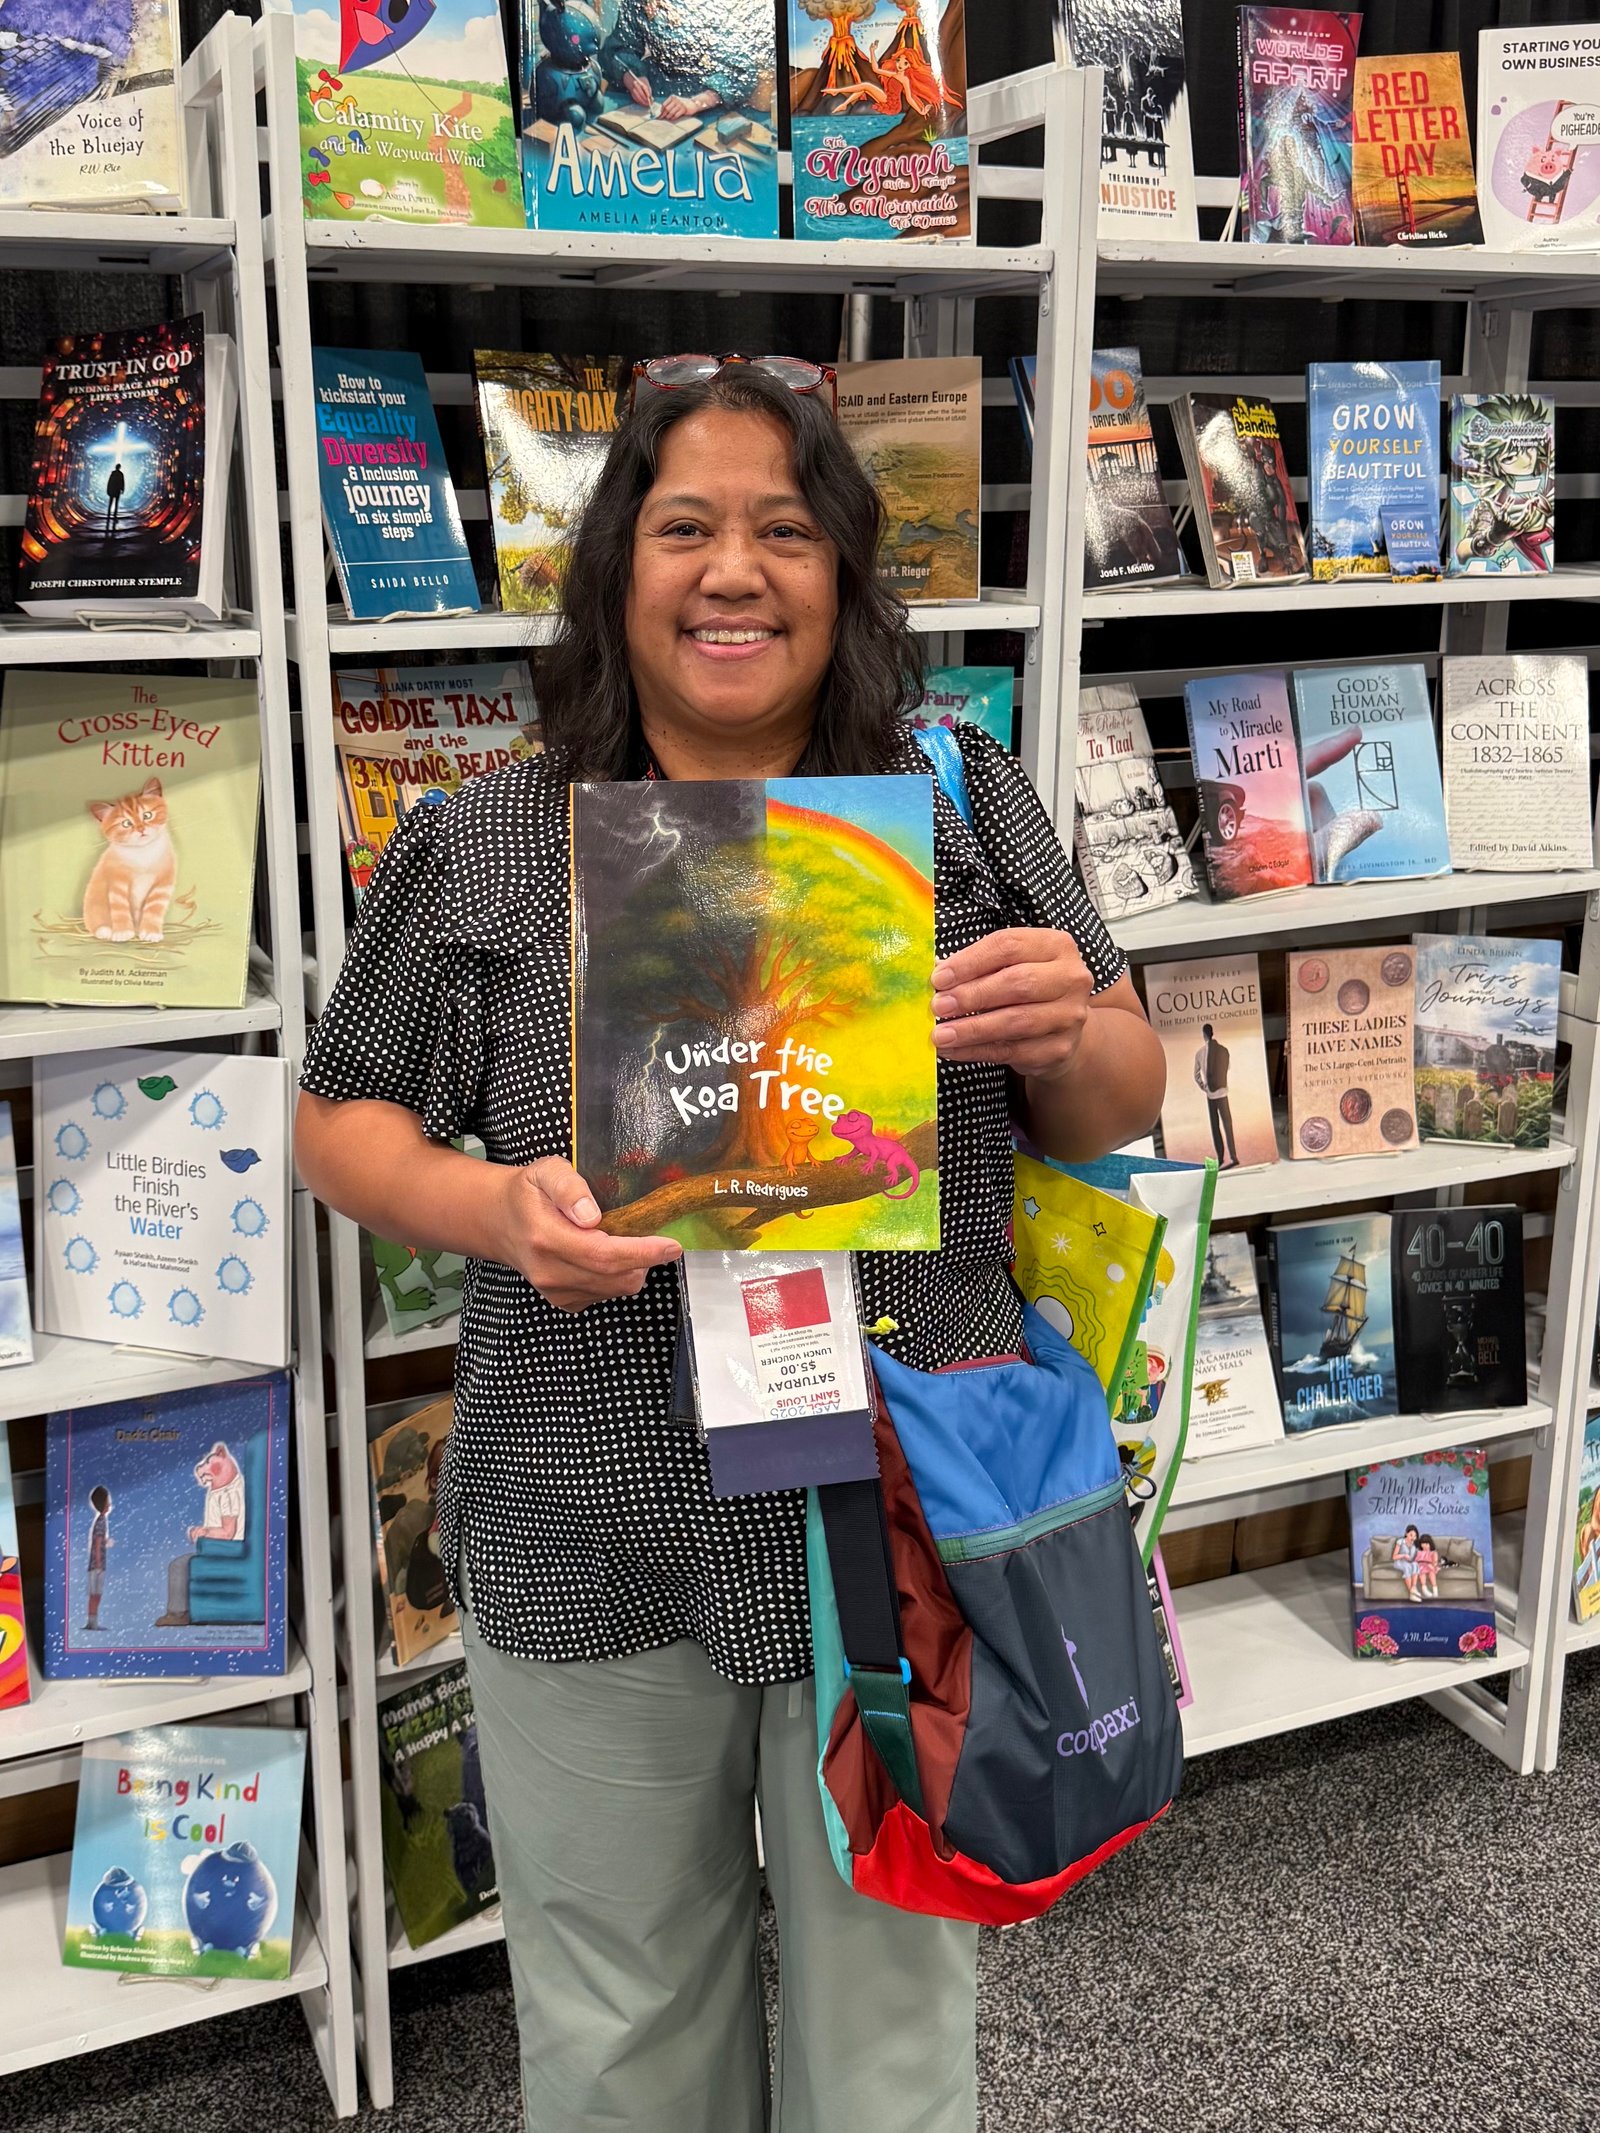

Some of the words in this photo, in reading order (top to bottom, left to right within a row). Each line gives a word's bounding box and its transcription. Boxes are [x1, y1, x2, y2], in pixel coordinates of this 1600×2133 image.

[1256, 38, 1344, 61] WORLDS
[1501, 58, 1536, 71] OWN
[1539, 56, 1600, 69] BUSINESS
[1253, 60, 1348, 91] APART
[1371, 71, 1430, 107] RED
[77, 112, 122, 129] Voice
[128, 108, 144, 132] of
[313, 98, 425, 140] Calamity
[431, 112, 484, 141] Kite
[1353, 106, 1461, 143] LETTER
[1573, 112, 1595, 122] You're
[49, 138, 75, 156] the
[83, 136, 144, 156] Bluejay
[319, 136, 346, 153] and
[351, 138, 372, 156] the
[375, 141, 444, 164] Wayward
[446, 149, 486, 169] Wind
[806, 143, 954, 195] Nymph
[1381, 143, 1437, 178] DAY
[1100, 183, 1177, 212] NJUSTICE
[579, 210, 639, 225] AMELIA
[650, 212, 725, 228] HEANTON
[55, 360, 121, 381] TRUST
[125, 358, 147, 376] IN
[151, 349, 194, 372] GOD
[68, 383, 111, 395] FINDING
[113, 380, 143, 392] PEACE
[145, 376, 181, 389] AMIDST
[337, 373, 366, 390] How
[368, 376, 382, 390] to
[583, 367, 606, 391] THE
[319, 387, 376, 405] kickstart
[381, 392, 407, 408] your
[866, 392, 886, 406] and
[889, 391, 929, 405] Eastern
[931, 390, 968, 405] Europe
[317, 403, 416, 442] Equality
[1092, 413, 1117, 428] DRIVE
[1117, 411, 1133, 426] ON!
[1332, 403, 1416, 432] GROW
[322, 437, 428, 470] Diversity
[1329, 437, 1424, 456] YOURSELF
[1511, 440, 1539, 448] Volume
[349, 465, 358, 481] &
[360, 466, 418, 481] Inclusion
[1327, 461, 1427, 481] BEAUTIFUL
[343, 479, 432, 515] journey
[355, 509, 369, 525] in
[371, 509, 391, 524] six
[392, 508, 433, 527] simple
[1391, 519, 1425, 531] GROW
[381, 525, 415, 542] steps
[370, 577, 407, 589] SAIDA
[413, 574, 450, 587] BELLO
[890, 565, 900, 578] R.
[901, 565, 931, 579] Rieger
[29, 579, 65, 590] JOSEPH
[67, 578, 136, 588] CHRISTOPHER
[138, 576, 183, 587] STEMPLE
[131, 685, 158, 704] The
[373, 680, 414, 694] JULIANA
[416, 679, 448, 692] DATRY
[449, 678, 474, 690] MOST
[1336, 676, 1391, 694] GOD'S
[1475, 679, 1556, 696] ACROSS
[924, 690, 970, 711] Fairy
[1208, 699, 1229, 719] My
[1232, 693, 1262, 713] Road
[1331, 692, 1400, 710] HUMAN
[1494, 701, 1538, 719] THE
[340, 698, 440, 735] GOLDIE
[443, 692, 519, 729] TAXI
[1330, 707, 1405, 726] BIOLOGY
[57, 708, 221, 750] Cross-Eyed
[1219, 726, 1229, 737] to
[1230, 715, 1283, 741] Miracle
[1451, 723, 1583, 742] CONTINENT
[404, 734, 434, 751] and
[439, 733, 469, 750] the
[1086, 738, 1104, 761] Ta
[1107, 731, 1135, 756] Taal
[102, 740, 186, 769] Kitten
[1214, 740, 1283, 780] Marti
[352, 757, 371, 789] 3
[373, 754, 452, 788] YOUNG
[1469, 843, 1497, 852] Edited
[1499, 843, 1509, 854] by
[1511, 843, 1537, 852] David
[1156, 984, 1257, 1015] COURAGE
[1419, 979, 1550, 1017] Journeys
[1159, 1019, 1173, 1028] THE
[1174, 1016, 1195, 1026] READY
[1196, 1013, 1218, 1024] FORCE
[1218, 1008, 1258, 1021] CONCEALED
[1302, 1019, 1350, 1036] THESE
[1354, 1014, 1407, 1032] LADIES
[1307, 1039, 1346, 1056] HAVE
[1350, 1034, 1403, 1052] NAMES
[664, 1037, 767, 1077] Under
[775, 1036, 833, 1077] the
[669, 1080, 740, 1126] Koa
[749, 1069, 847, 1122] Tree
[106, 1151, 147, 1173] Little
[152, 1156, 207, 1179] Birdies
[133, 1175, 180, 1198] Finish
[714, 1179, 728, 1195] L.
[730, 1179, 744, 1195] R.
[745, 1179, 810, 1200] Rodrigues
[115, 1194, 141, 1215] the
[146, 1199, 199, 1221] River's
[130, 1216, 183, 1240] Water
[1424, 1269, 1447, 1281] YEARS
[1448, 1269, 1458, 1280] OF
[1460, 1267, 1488, 1279] CAREER
[1489, 1266, 1504, 1278] LIFE
[1416, 1282, 1443, 1295] ADVICE
[1444, 1281, 1453, 1292] IN
[1455, 1280, 1465, 1291] 40
[1469, 1278, 1500, 1290] MINUTES
[760, 1352, 802, 1367] VOUCHER
[803, 1347, 833, 1358] LUNCH
[1206, 1348, 1253, 1364] CAMPAIGN
[1478, 1351, 1500, 1365] BELL
[780, 1359, 817, 1376] $5.00
[1327, 1355, 1354, 1383] THE
[767, 1372, 836, 1394] SATURDAY
[1296, 1373, 1384, 1413] CHALLENGER
[770, 1405, 808, 1420] 2025
[150, 1427, 181, 1442] Chair
[1379, 1477, 1405, 1498] My
[1407, 1476, 1456, 1496] Mother
[1368, 1497, 1400, 1516] Told
[1401, 1497, 1424, 1516] Me
[1426, 1497, 1470, 1516] Stories
[1056, 1695, 1141, 1758] cotpaxi
[394, 1747, 406, 1763] A
[406, 1726, 449, 1757] Happy
[451, 1720, 462, 1734] A
[196, 1771, 261, 1803] Kind
[172, 1813, 226, 1845] Cool
